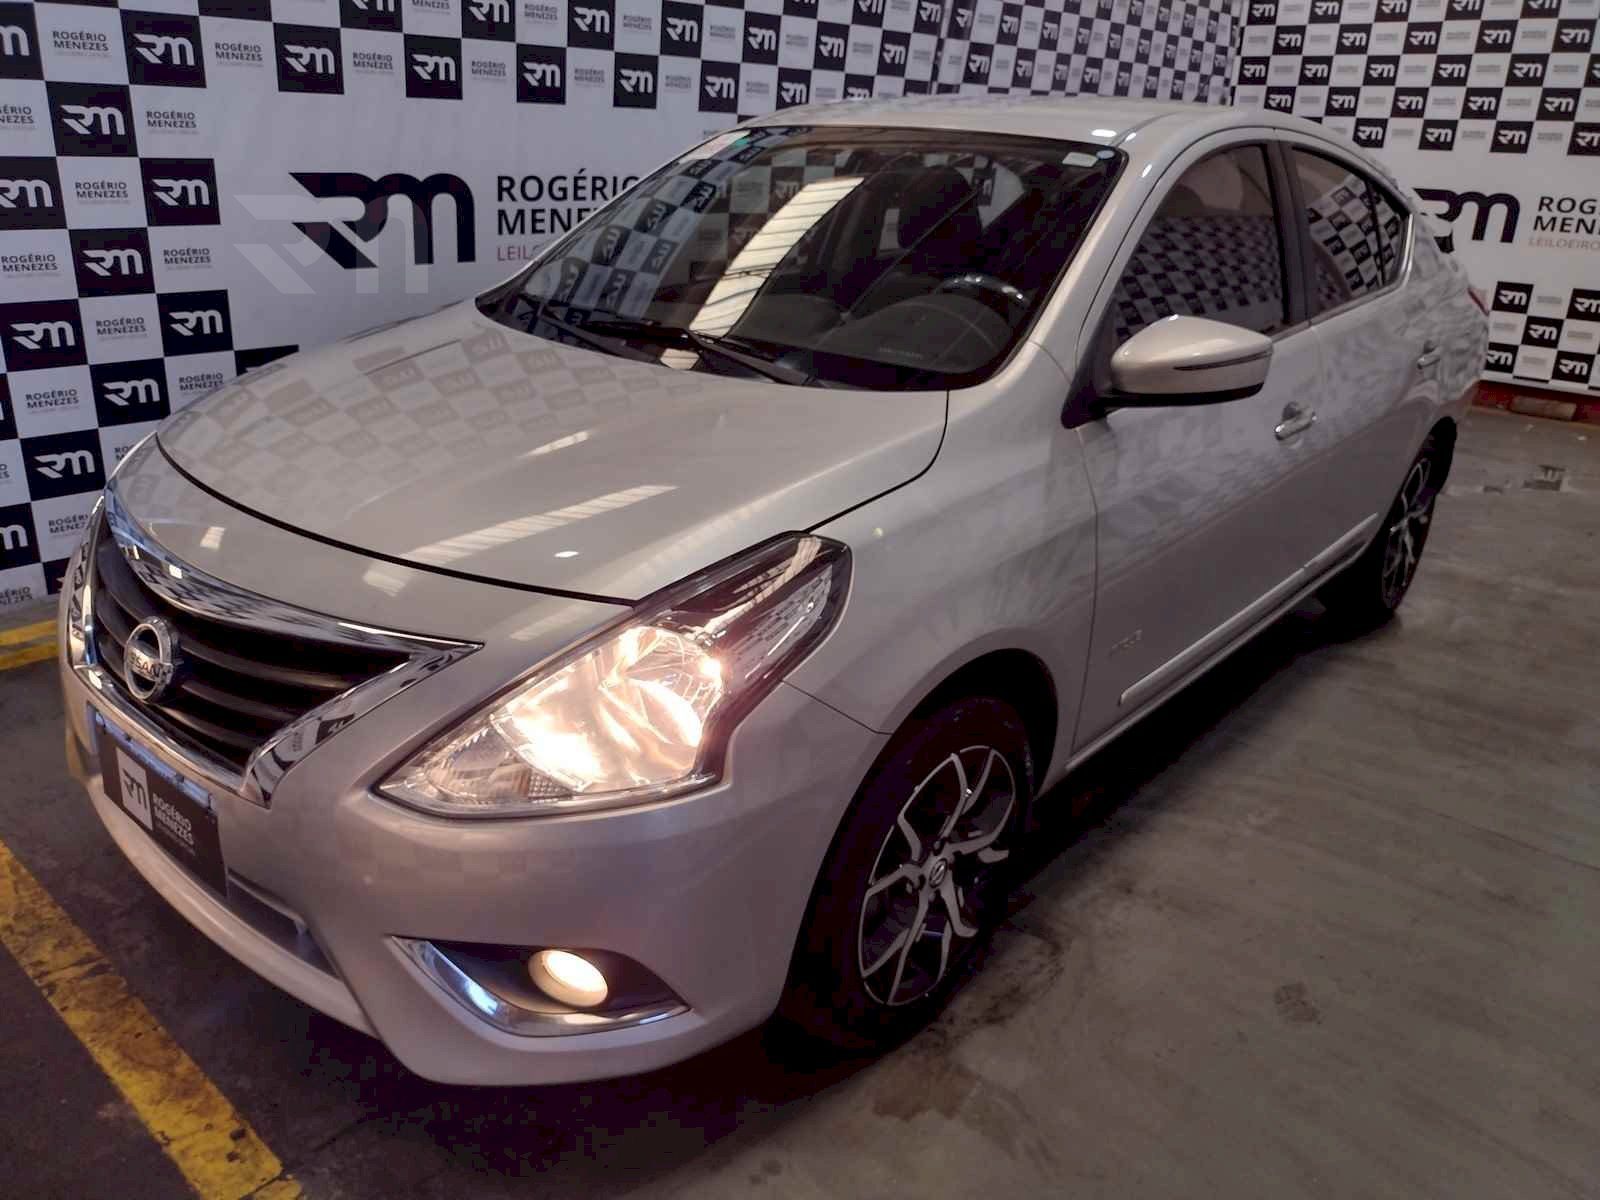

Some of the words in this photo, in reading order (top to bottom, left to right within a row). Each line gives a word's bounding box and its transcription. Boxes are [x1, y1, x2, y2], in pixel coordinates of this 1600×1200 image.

[52, 31, 107, 42] ROGÉRIO
[53, 40, 109, 51] MENEZES
[215, 42, 261, 53] ROGÉRIO
[215, 51, 263, 62] MENEZES
[146, 110, 196, 121] ROGÉRIO
[147, 119, 197, 129] MENEZES
[75, 180, 127, 191] ROGÉRIO
[76, 189, 129, 198] MENEZES
[1538, 196, 1600, 214] ROG
[497, 208, 598, 236] MENE
[1533, 215, 1600, 235] MEN
[1, 252, 56, 263] ROGÉRIO
[163, 247, 210, 257] ROGÉRIO
[164, 256, 212, 265] MENEZES
[2, 262, 58, 273] MENEZES
[96, 316, 145, 327] ROGÉRIO
[97, 325, 147, 336] MENEZES
[179, 372, 223, 384] ROGÉRIO
[26, 388, 78, 401] ROGÉRIO
[27, 398, 79, 409] MENEZES
[49, 514, 89, 527] ROGÉRI
